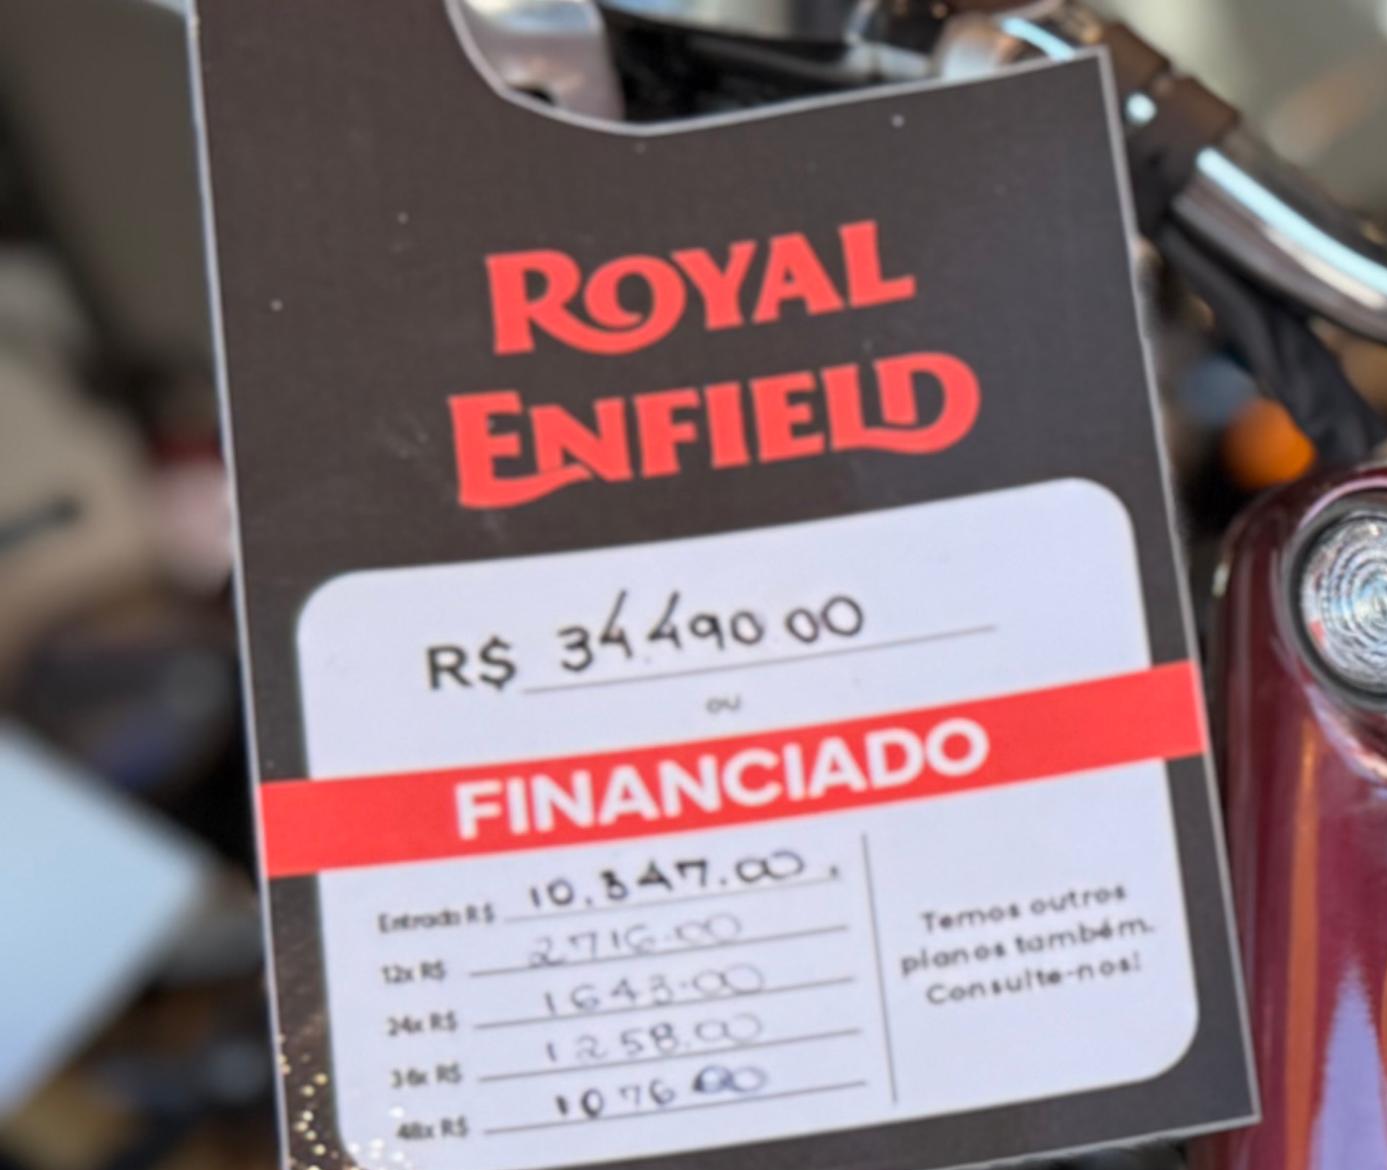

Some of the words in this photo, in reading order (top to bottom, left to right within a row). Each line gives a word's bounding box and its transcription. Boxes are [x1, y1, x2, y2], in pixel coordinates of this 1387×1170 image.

[485, 220, 915, 355] ROYAL
[448, 353, 980, 507] ENFIELD
[426, 636, 517, 690] R$
[706, 694, 741, 713] ou
[453, 716, 990, 841] FINANCIADO
[921, 903, 1020, 933] Temos
[1030, 885, 1126, 916] outros
[381, 965, 414, 984] 12x
[420, 960, 445, 980] R$
[900, 942, 1006, 978] planos
[1015, 916, 1153, 955] também.
[925, 950, 1141, 1005] Consulte-nos!
[387, 1015, 423, 1037] 24x
[429, 1009, 457, 1032] R$
[391, 1067, 427, 1089] 36x
[435, 1062, 462, 1084] R$
[440, 1114, 468, 1138] R$
